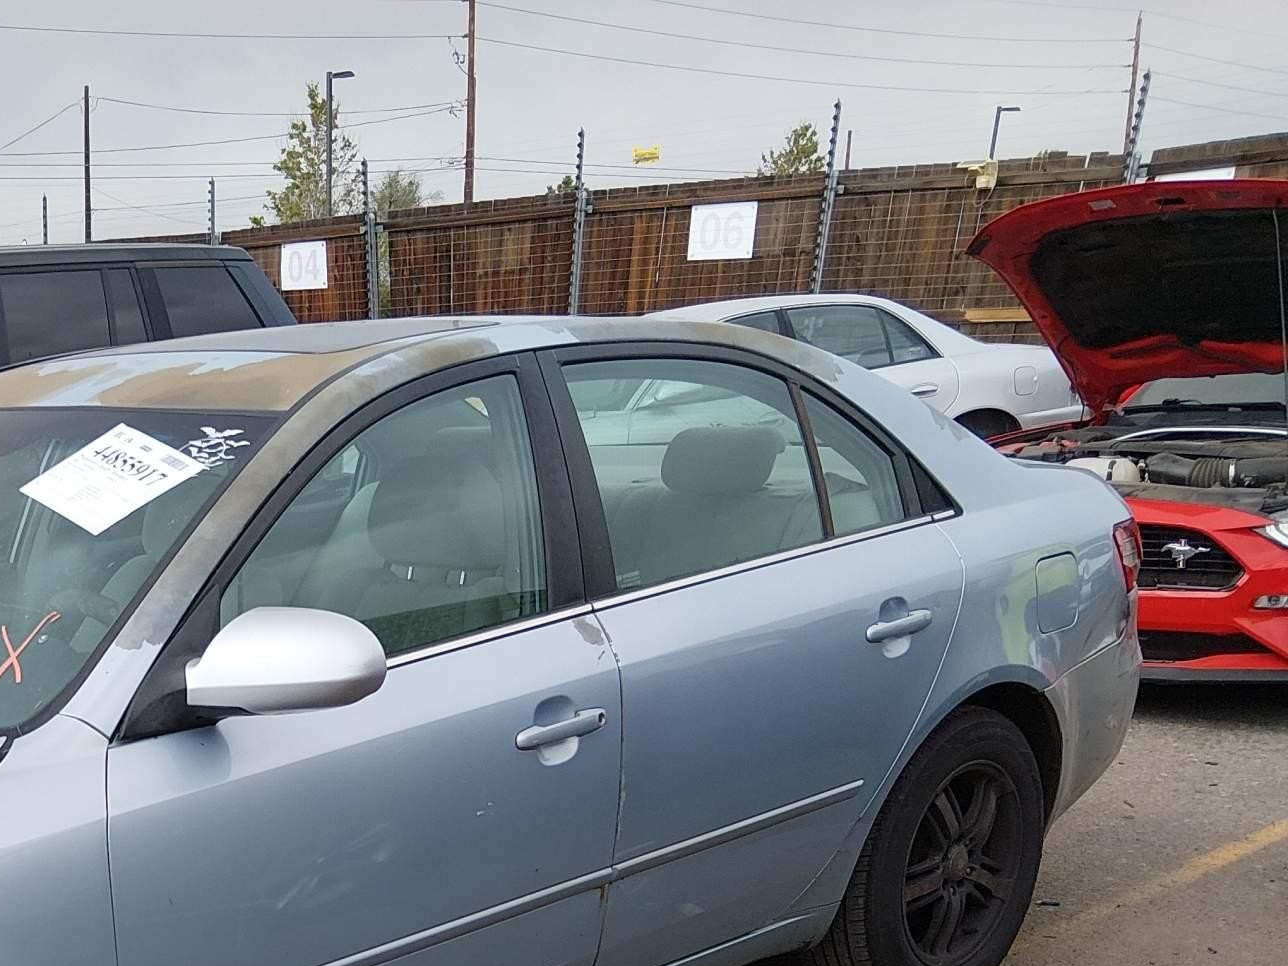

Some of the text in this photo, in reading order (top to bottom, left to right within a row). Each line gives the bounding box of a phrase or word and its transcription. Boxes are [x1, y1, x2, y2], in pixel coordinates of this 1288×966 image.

[700, 212, 744, 251] 06
[288, 249, 318, 282] 04
[93, 445, 168, 486] 44855917
